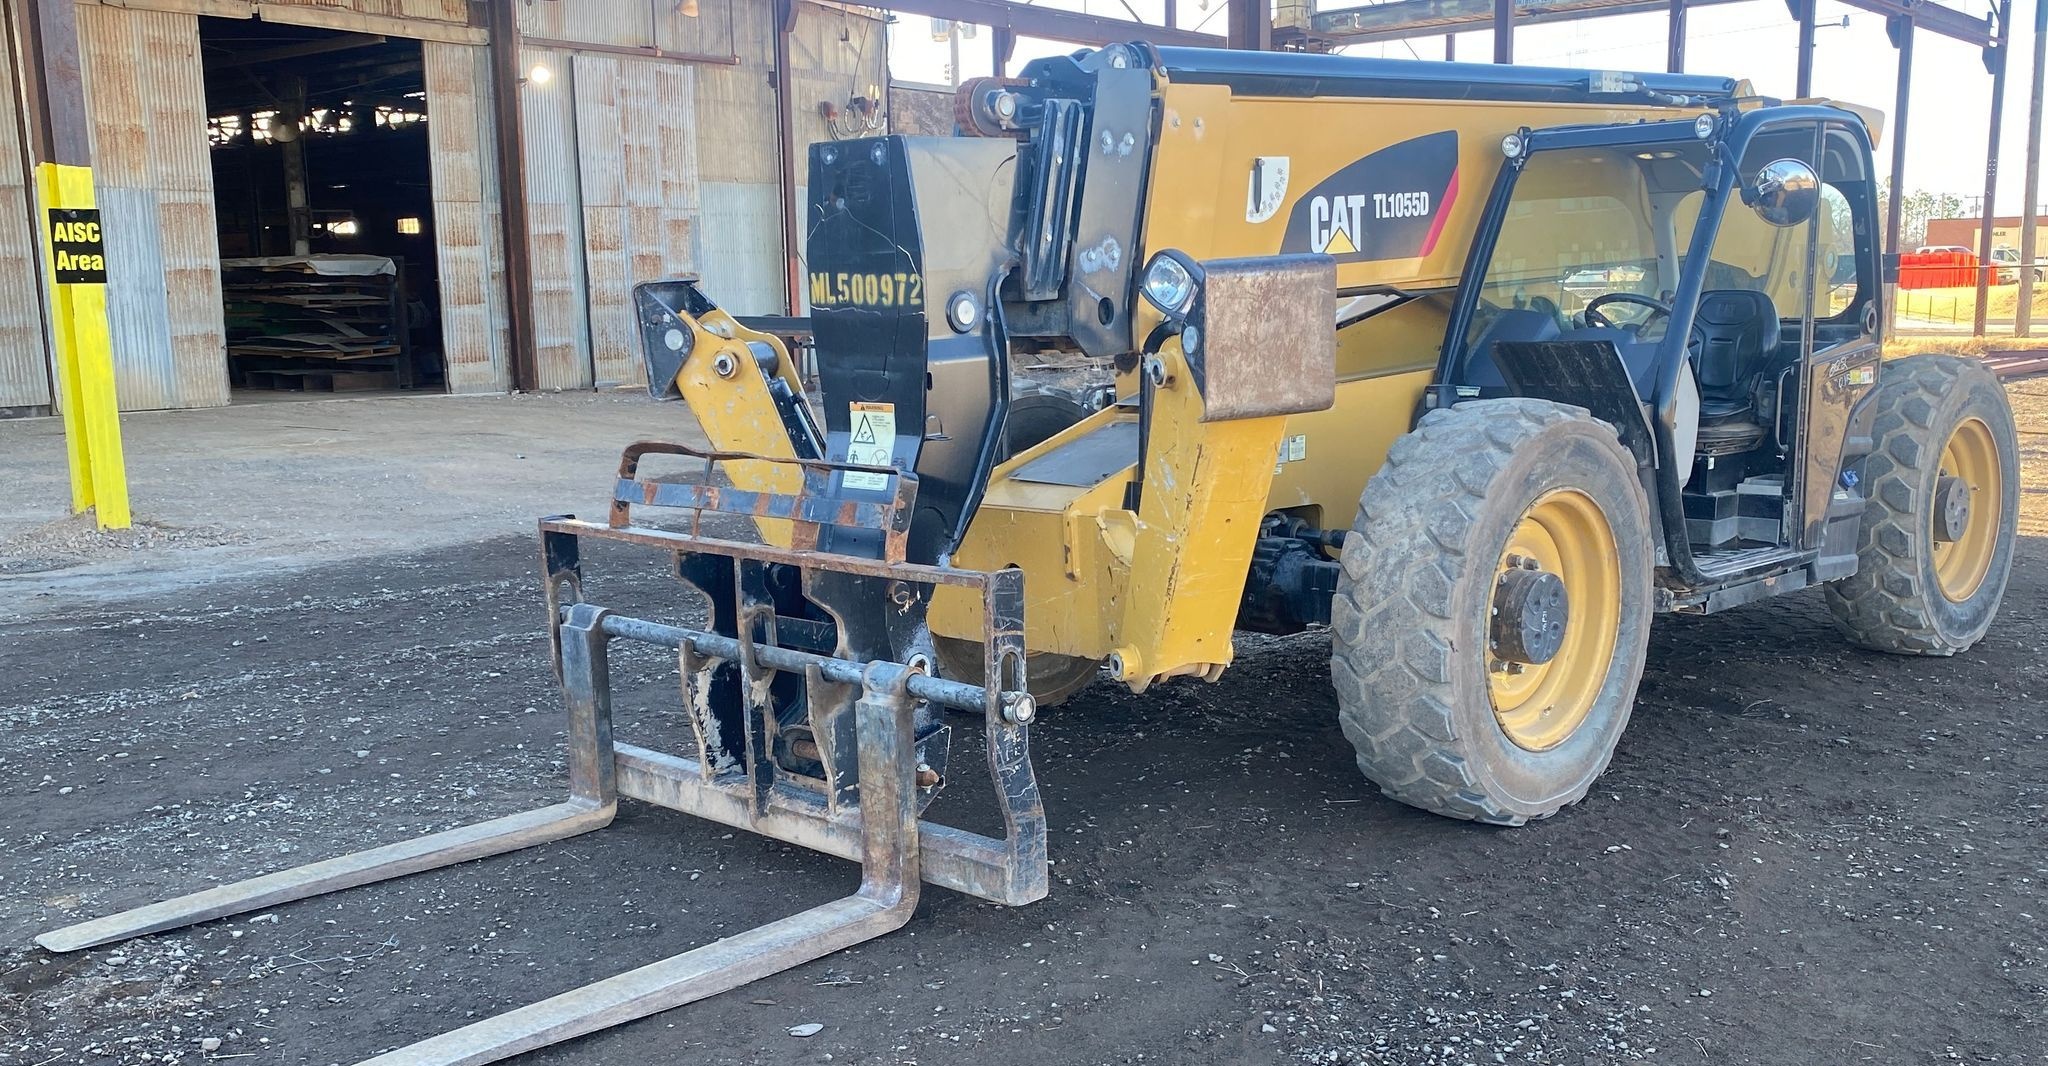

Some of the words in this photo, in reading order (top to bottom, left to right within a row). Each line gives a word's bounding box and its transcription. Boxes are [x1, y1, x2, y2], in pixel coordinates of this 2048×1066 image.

[54, 222, 101, 243] AISC
[1310, 195, 1365, 254] CAT
[1373, 191, 1430, 219] TL1055D
[56, 250, 104, 271] Area
[809, 272, 922, 306] ML500972
